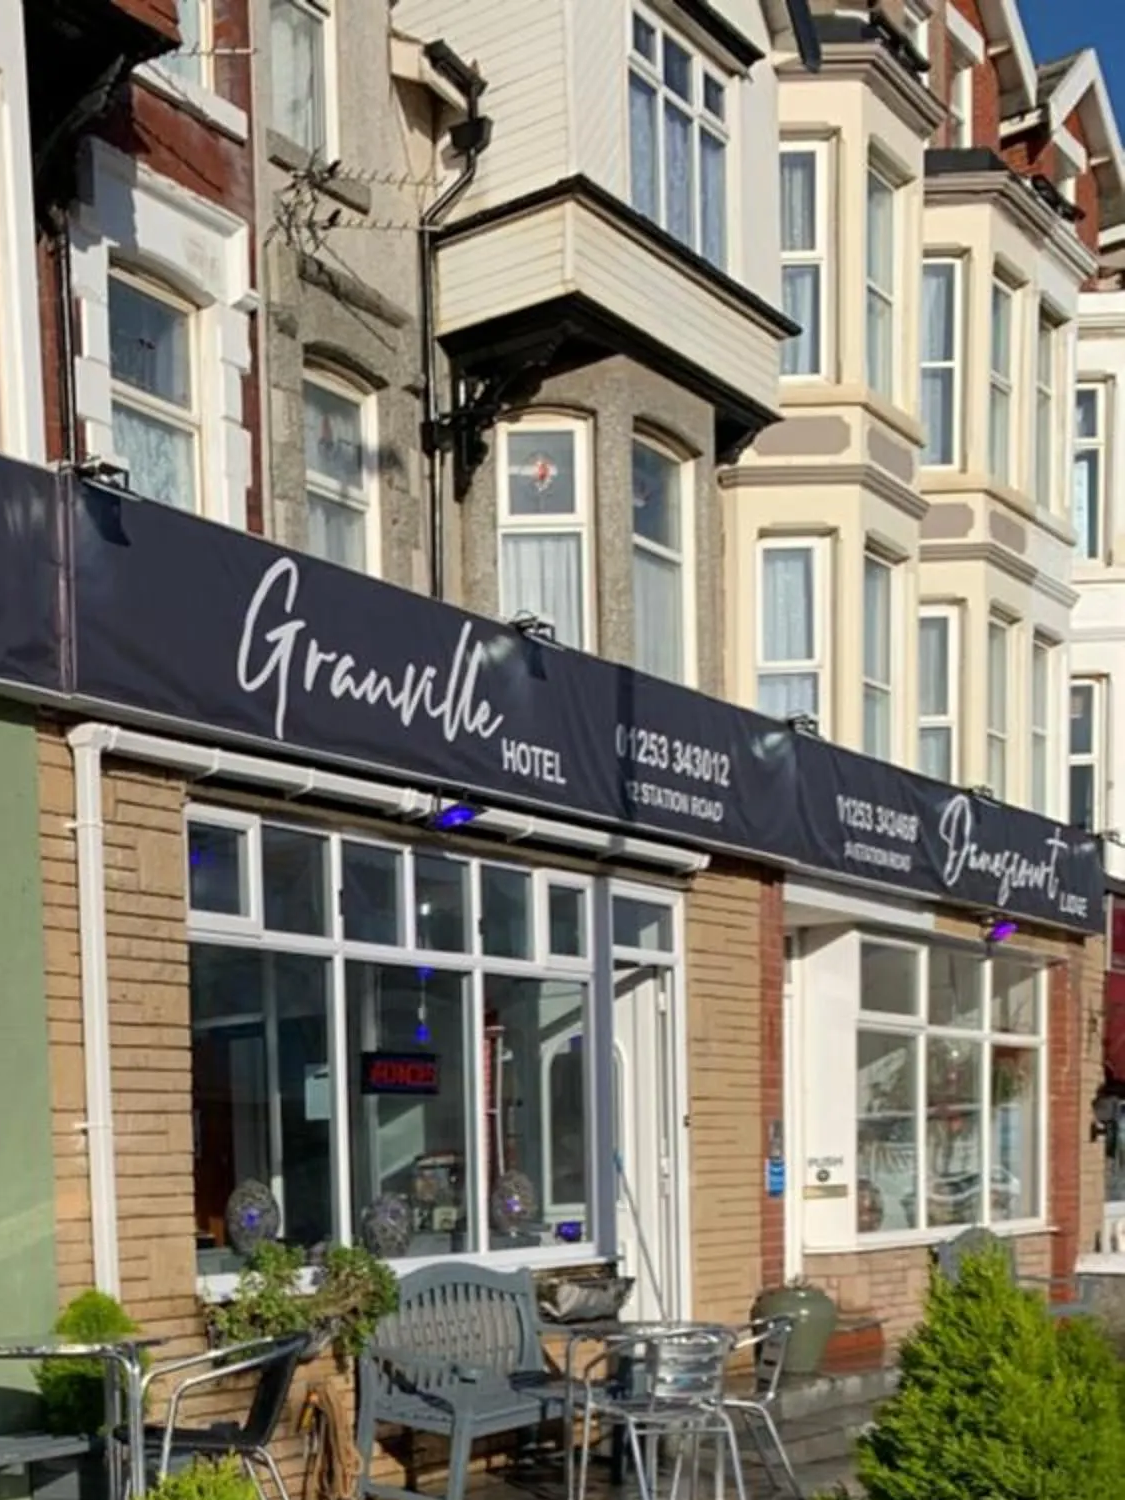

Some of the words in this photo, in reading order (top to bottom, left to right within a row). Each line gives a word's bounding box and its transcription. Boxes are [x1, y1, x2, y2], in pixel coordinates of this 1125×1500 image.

[237, 557, 505, 742] Granville
[501, 737, 567, 785] HOTEL
[615, 723, 669, 770] 01253
[672, 739, 731, 788] 343012
[641, 782, 690, 815] STATION
[691, 795, 724, 823] ROAD
